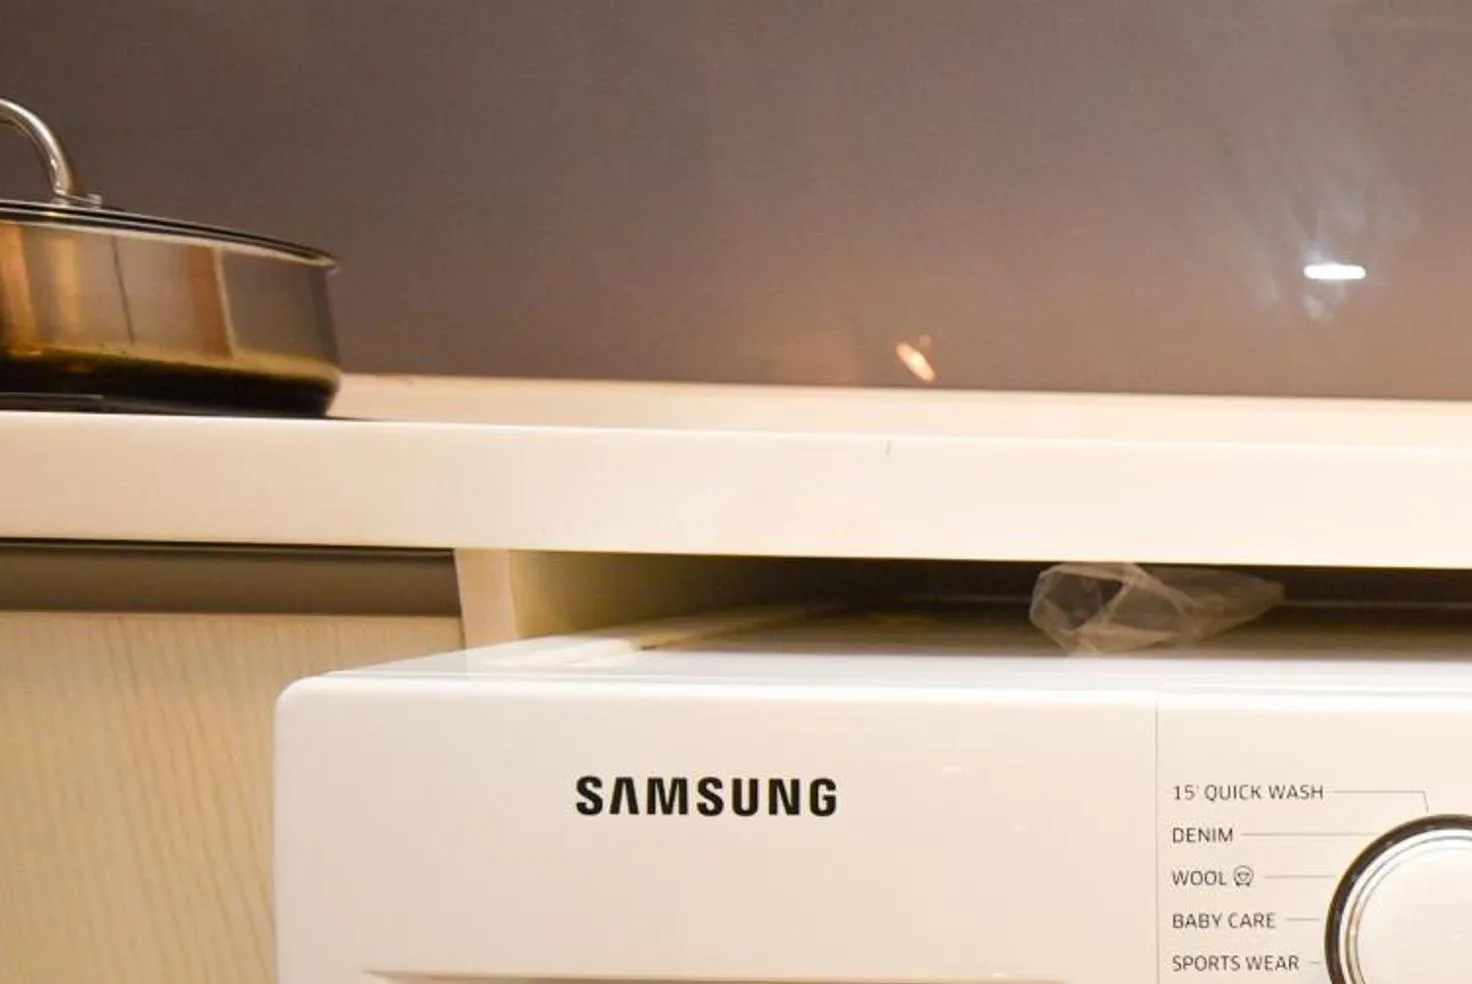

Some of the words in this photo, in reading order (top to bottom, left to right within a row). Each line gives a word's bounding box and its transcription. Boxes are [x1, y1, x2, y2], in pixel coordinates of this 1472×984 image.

[576, 776, 836, 816] SAMSUNG
[1204, 785, 1261, 802] QUICK
[1269, 785, 1323, 799] WASH
[1173, 828, 1232, 843] DENIM
[1173, 871, 1227, 886] WOOL
[1173, 914, 1222, 929] BABY
[1227, 913, 1276, 929] CARE
[1173, 955, 1240, 971] SPORTS
[1246, 955, 1300, 971] WEAR
